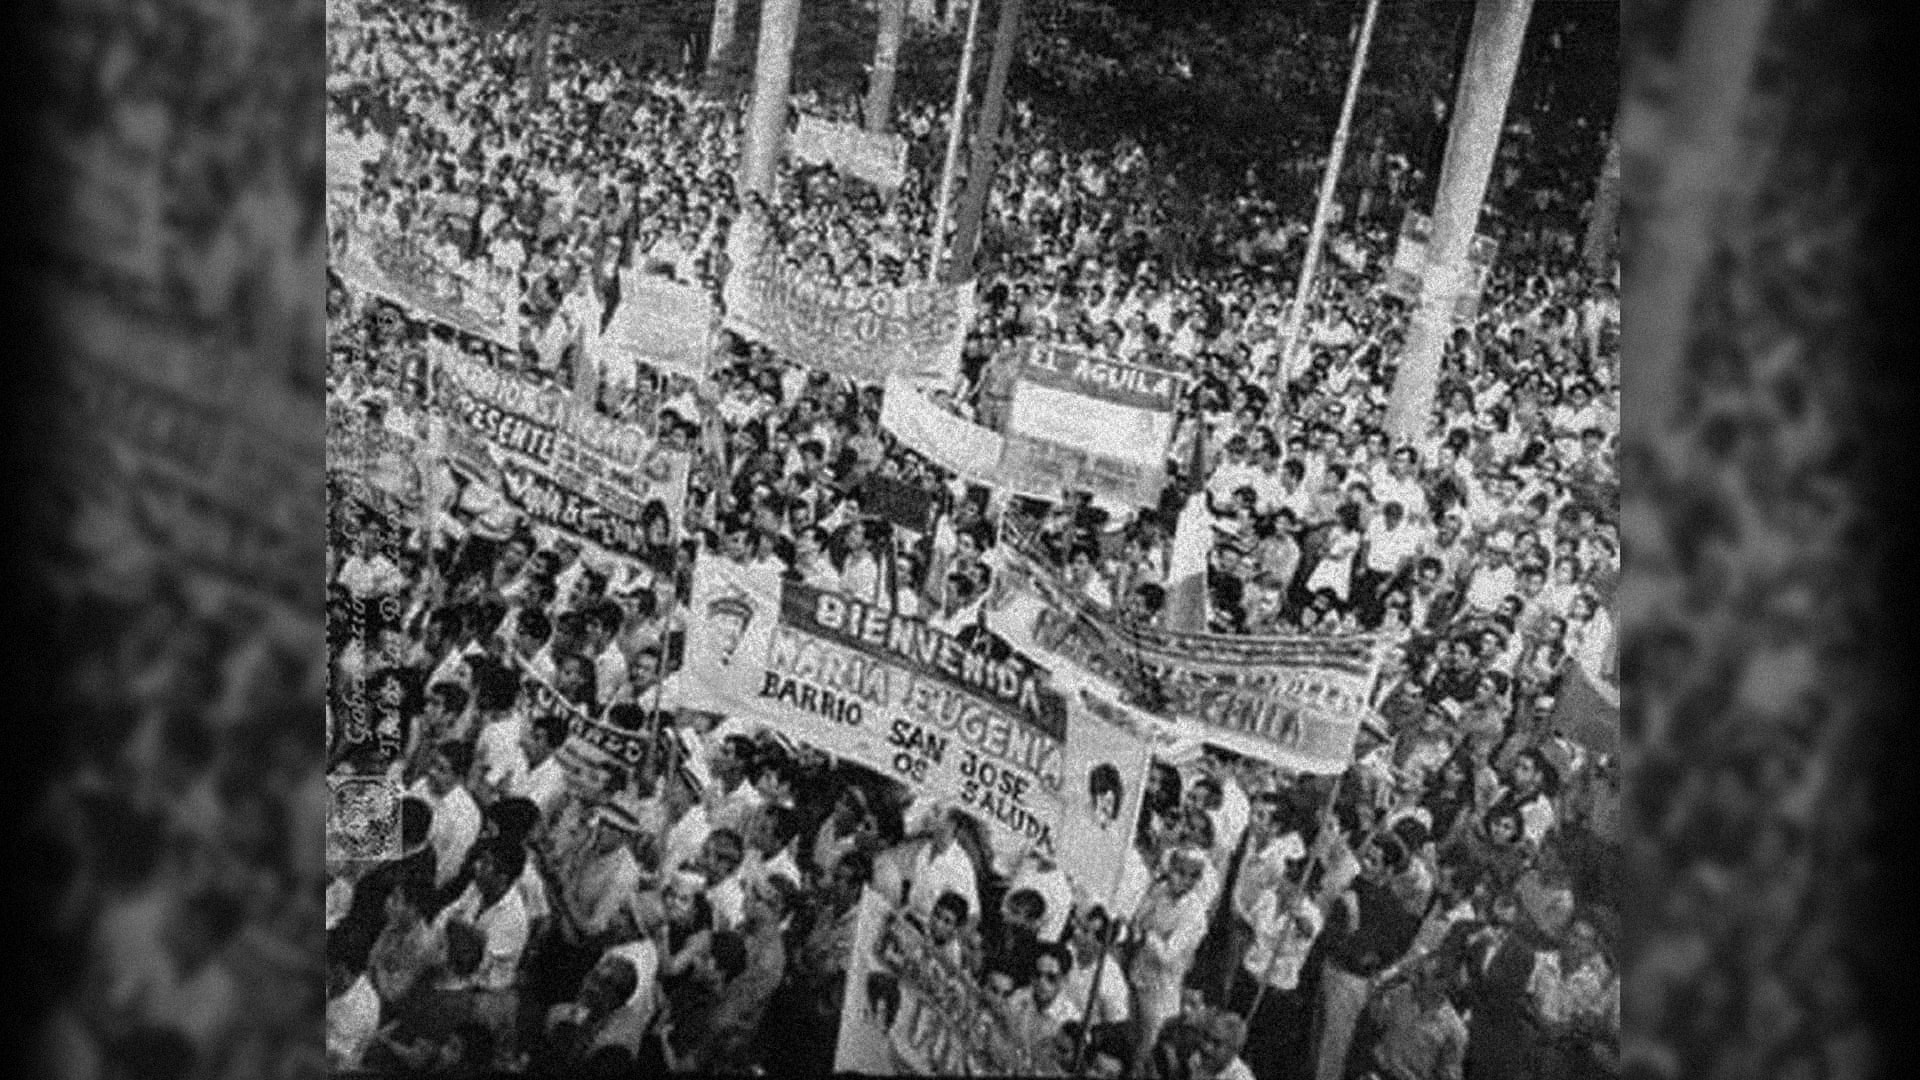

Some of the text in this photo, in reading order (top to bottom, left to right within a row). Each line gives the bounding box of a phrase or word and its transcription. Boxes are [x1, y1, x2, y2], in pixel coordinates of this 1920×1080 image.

[767, 626, 890, 707] MARIA
[905, 677, 1065, 793] EUGENIA
[815, 595, 1041, 716] BIENVENIDA
[759, 670, 1031, 801] BARRIO SAN JOSE
[893, 752, 1057, 853] OS SALUDA
